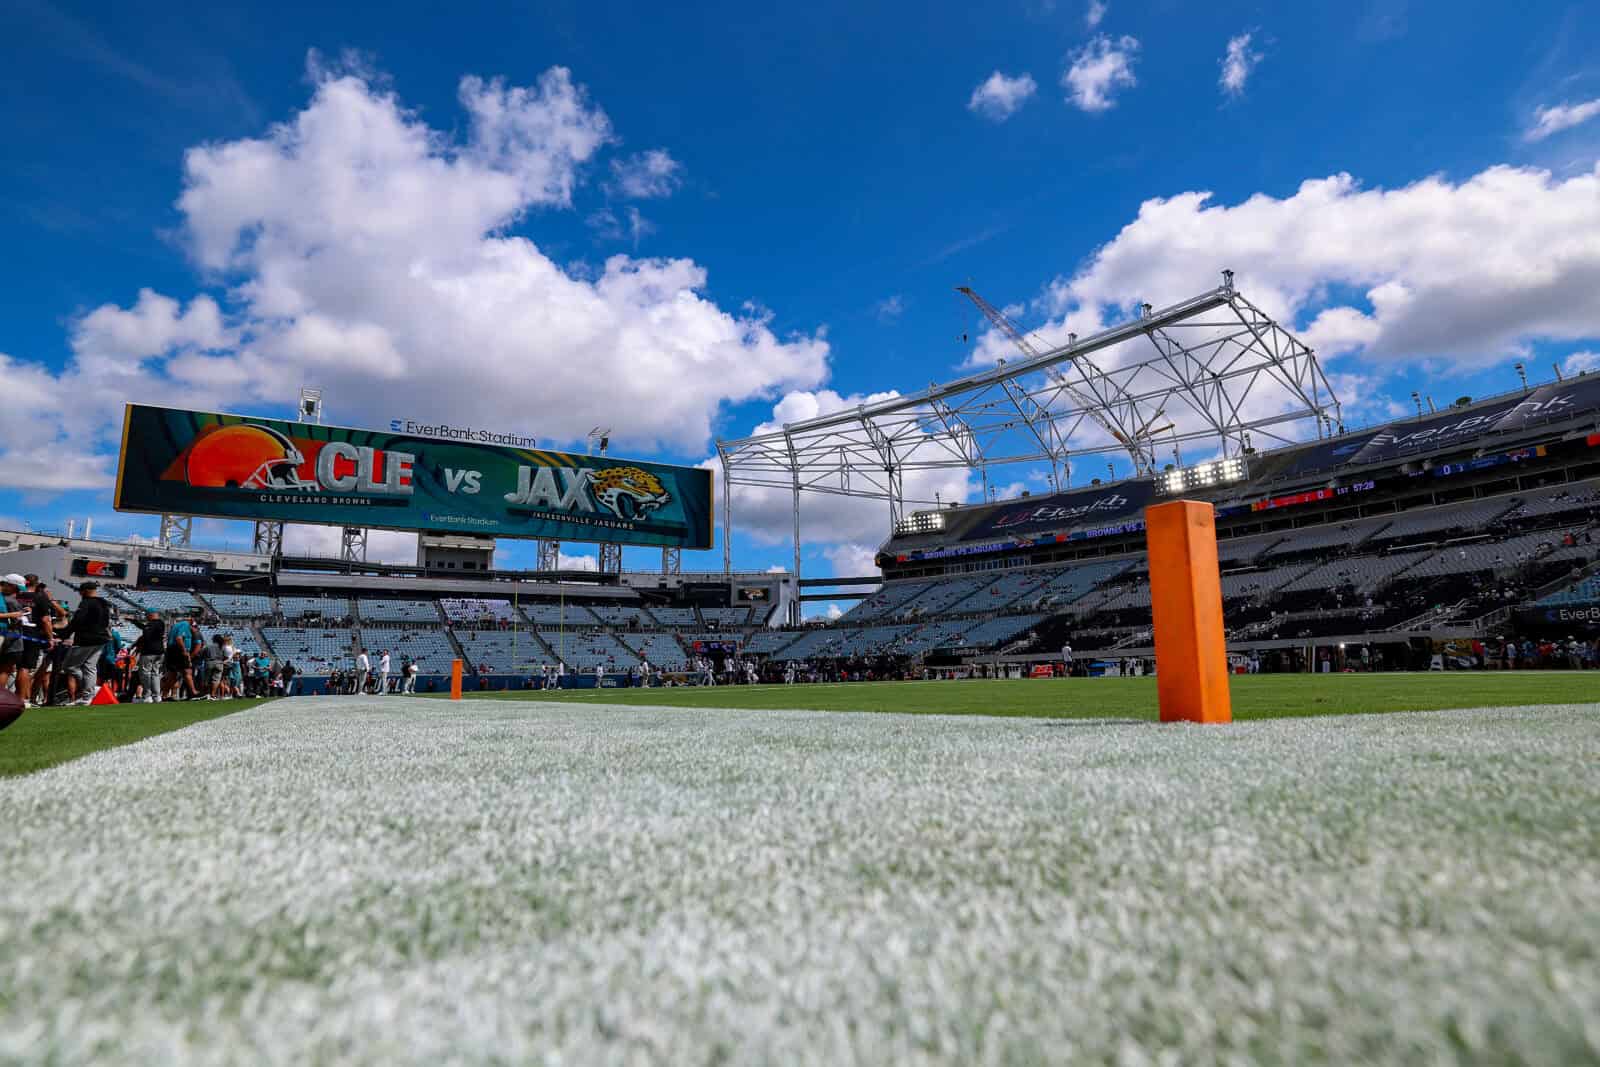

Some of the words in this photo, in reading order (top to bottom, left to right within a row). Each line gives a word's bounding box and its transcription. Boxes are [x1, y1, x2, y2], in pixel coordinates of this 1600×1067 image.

[406, 421, 475, 440] EverBank
[479, 430, 536, 448] Stadium
[317, 442, 415, 493] CLE
[444, 467, 483, 494] VS
[260, 494, 328, 504] CLEVELAND
[504, 465, 597, 512] JAX
[593, 519, 634, 530] JAGUARS
[149, 563, 172, 571] BUD
[173, 565, 204, 574] LIGHT
